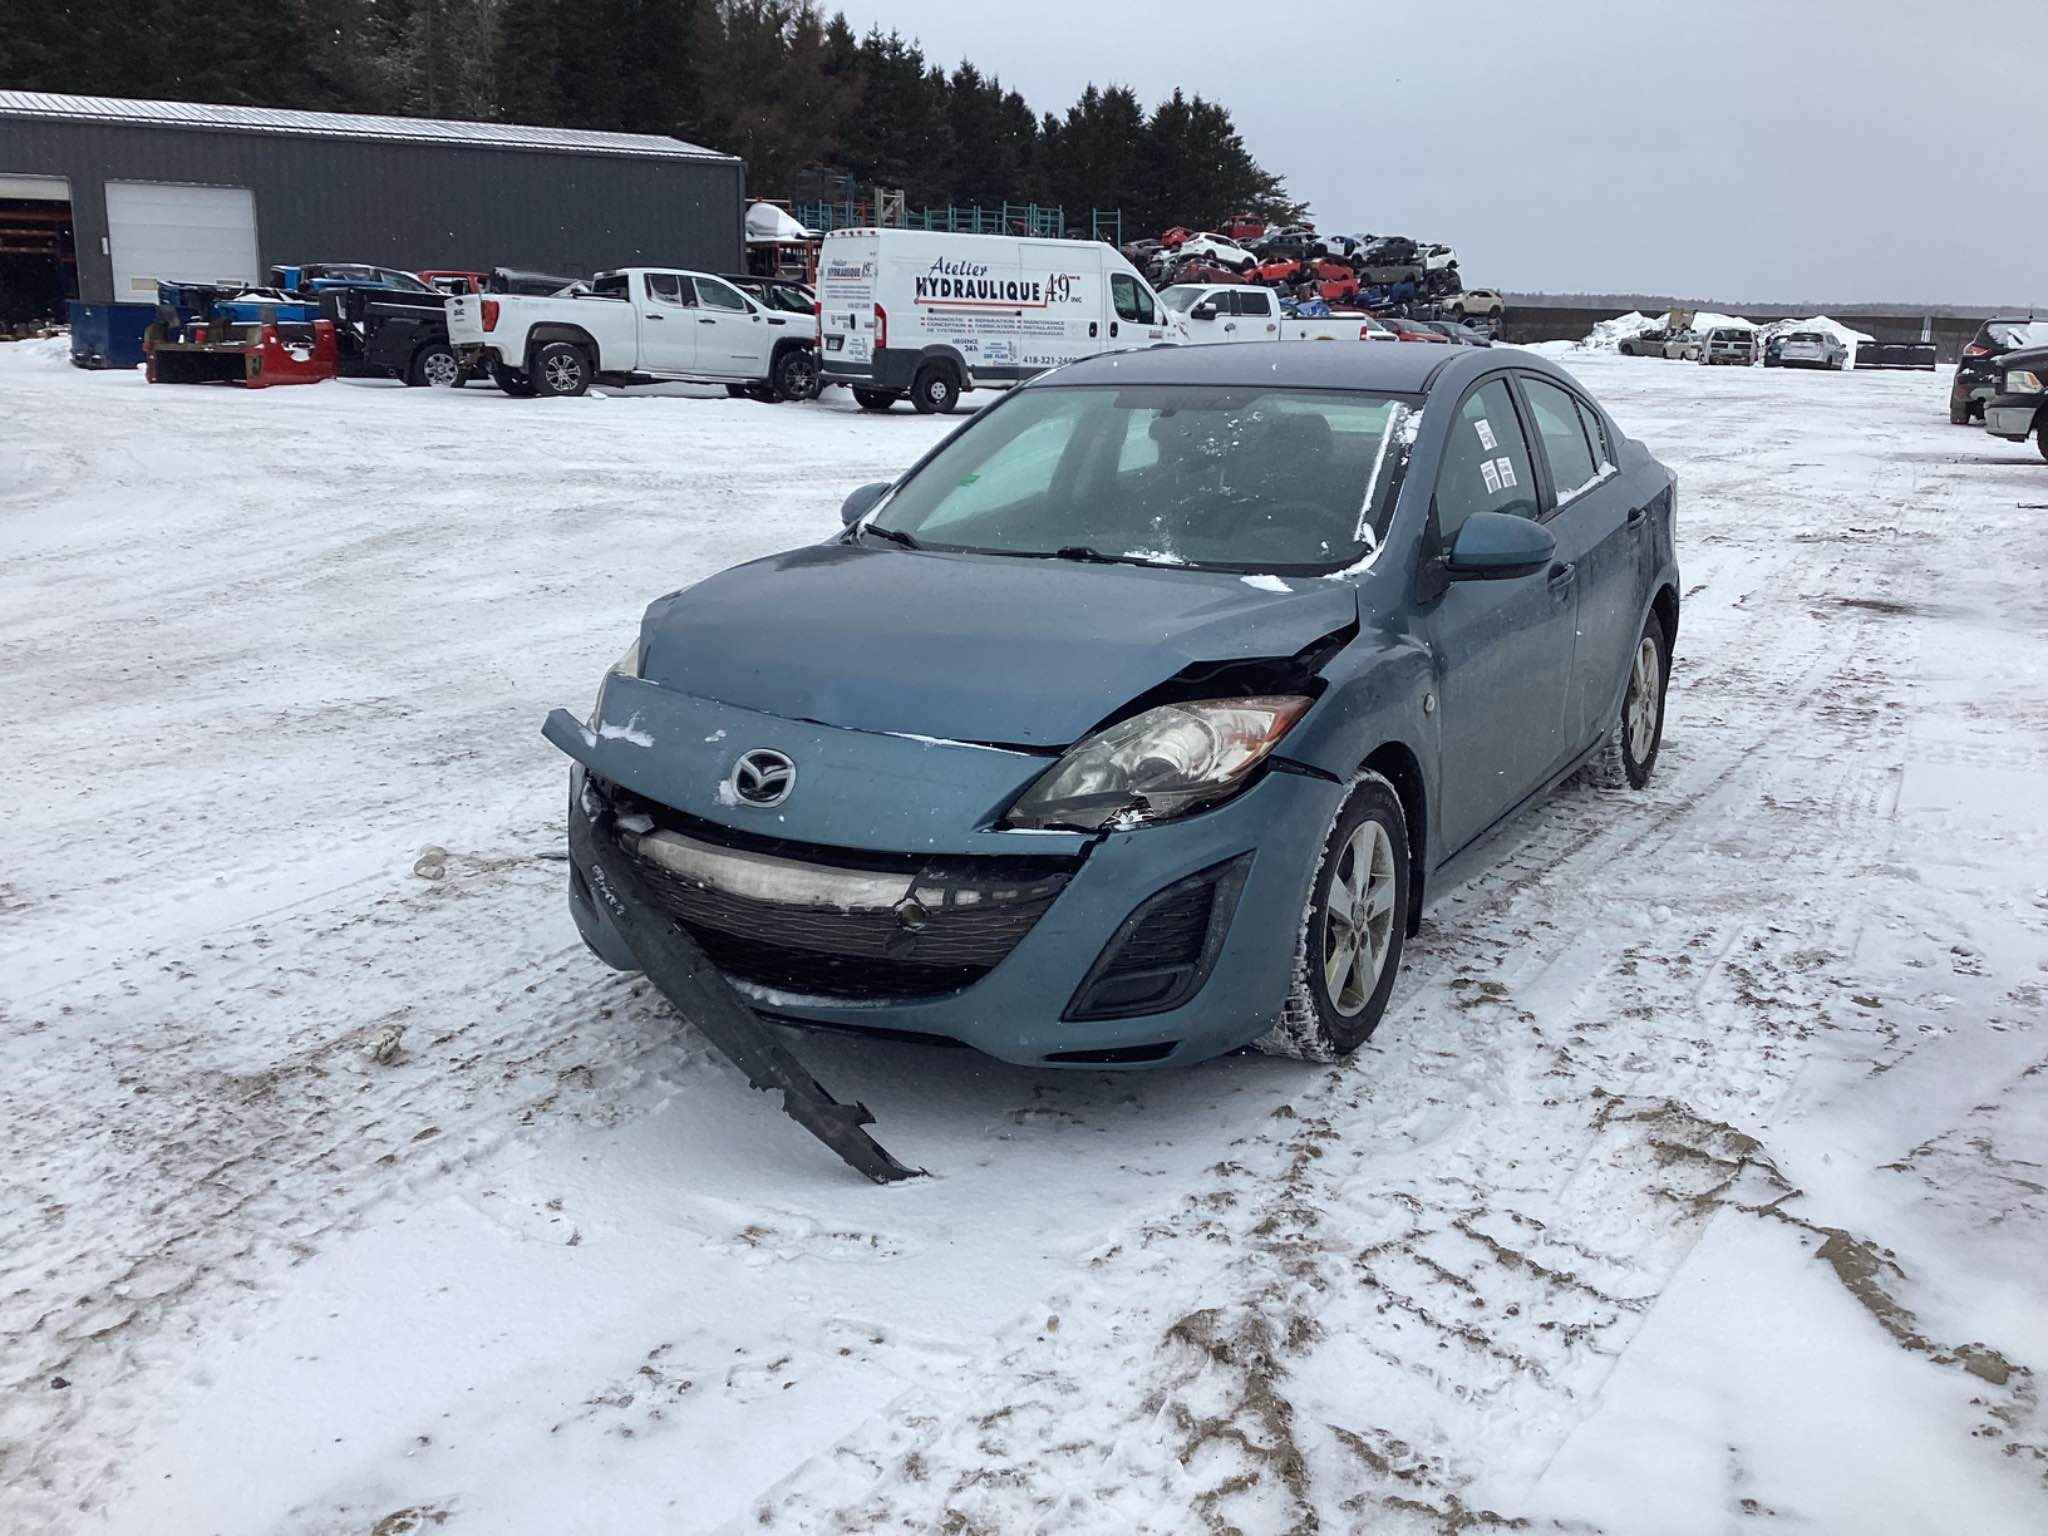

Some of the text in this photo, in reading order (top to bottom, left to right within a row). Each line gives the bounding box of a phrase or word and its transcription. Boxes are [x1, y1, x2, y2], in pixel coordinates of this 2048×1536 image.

[928, 256, 988, 277] Atelier
[916, 277, 1040, 301] HYDRAULIQUE
[1045, 273, 1070, 303] 49
